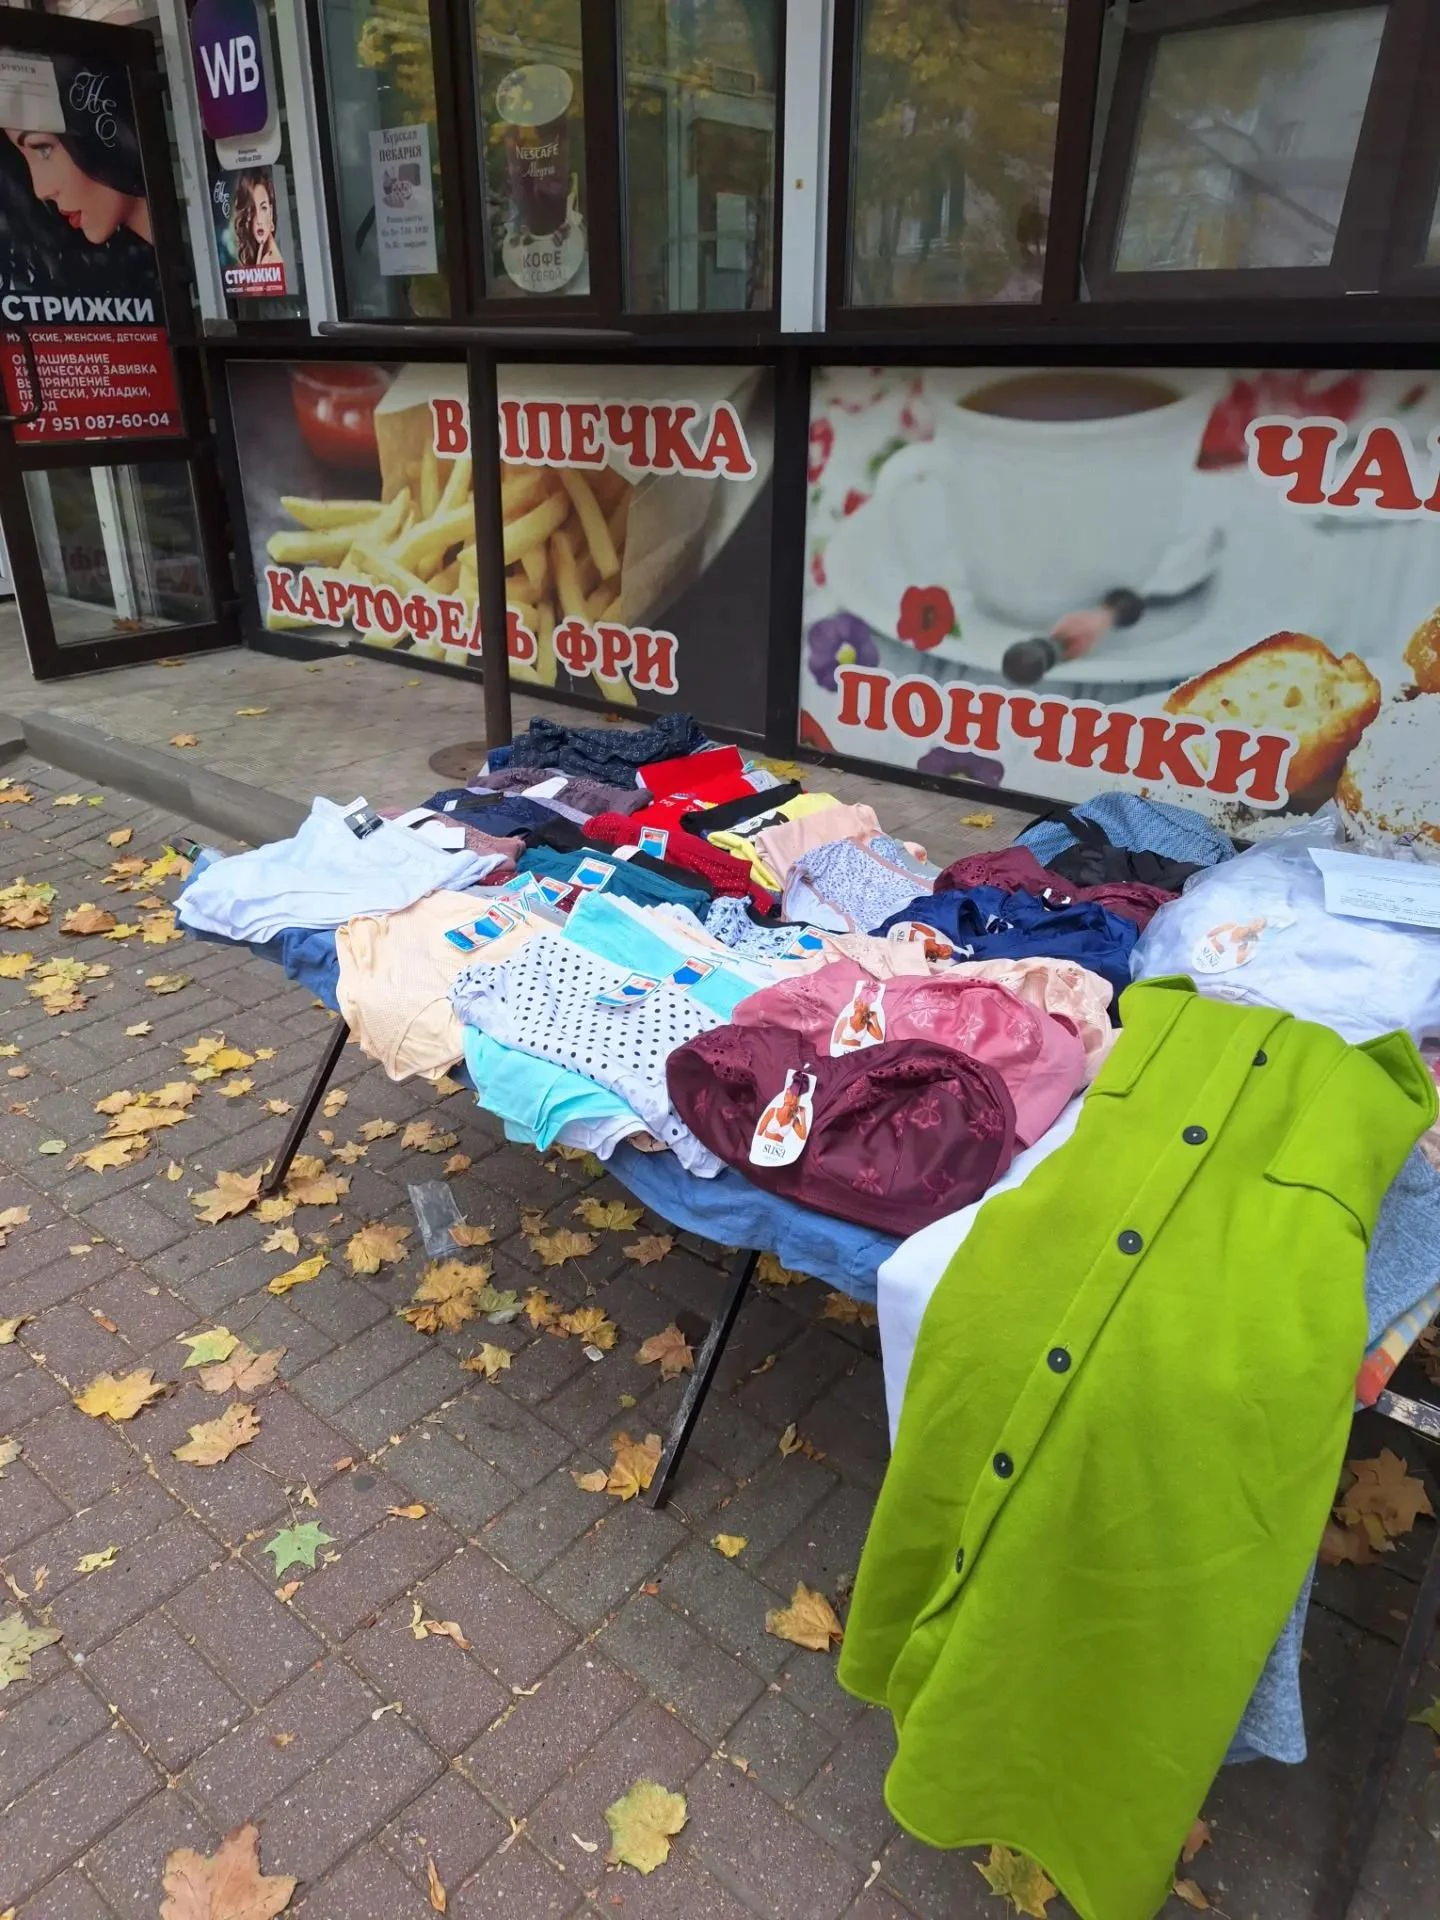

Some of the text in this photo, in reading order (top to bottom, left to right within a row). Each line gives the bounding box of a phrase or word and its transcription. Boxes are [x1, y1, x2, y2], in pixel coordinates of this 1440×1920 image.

[201, 35, 260, 99] WB
[523, 251, 562, 268] КОФЕ
[225, 267, 281, 284] СТРИЖКИ
[1, 294, 154, 321] СТРИЖКИ
[6, 333, 62, 342] МУСКИЕ,
[117, 333, 158, 342] ДЕТСКИЕ
[103, 364, 157, 375] ЗАВИВКА
[19, 386, 151, 400] ПРЧЕСКИ, УКЛАДКИ,
[27, 412, 170, 432] +7 951 087-60-04
[1253, 424, 1440, 512] ЧА
[556, 621, 676, 689] ФРИ
[837, 671, 1291, 802] ПОНЧИКИ
